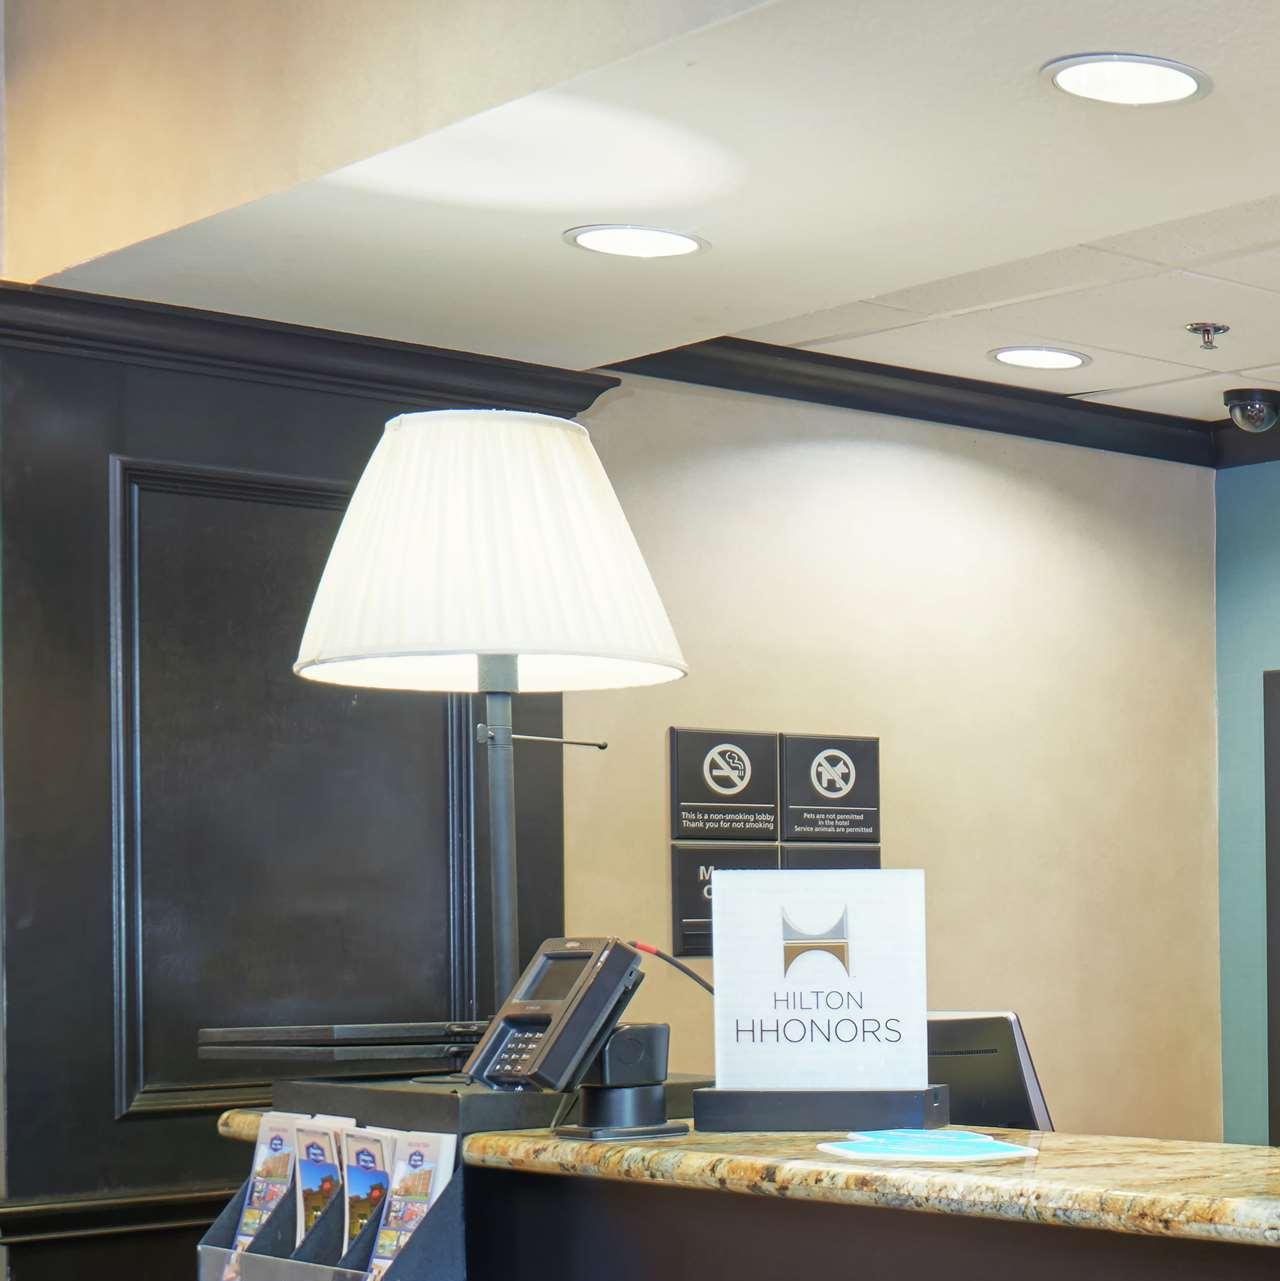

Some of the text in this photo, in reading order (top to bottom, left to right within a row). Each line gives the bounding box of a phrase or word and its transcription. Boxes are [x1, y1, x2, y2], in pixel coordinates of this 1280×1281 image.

[681, 811, 696, 820] This
[709, 812, 754, 822] non-smoking
[755, 812, 775, 822] lobby
[803, 812, 815, 820] Pets
[837, 813, 864, 821] permitted
[682, 820, 774, 830] Thank you for not smoking
[815, 825, 836, 833] animals
[845, 826, 873, 835] permitted
[773, 990, 864, 1010] HILTON
[735, 1018, 902, 1043] HHONORS
